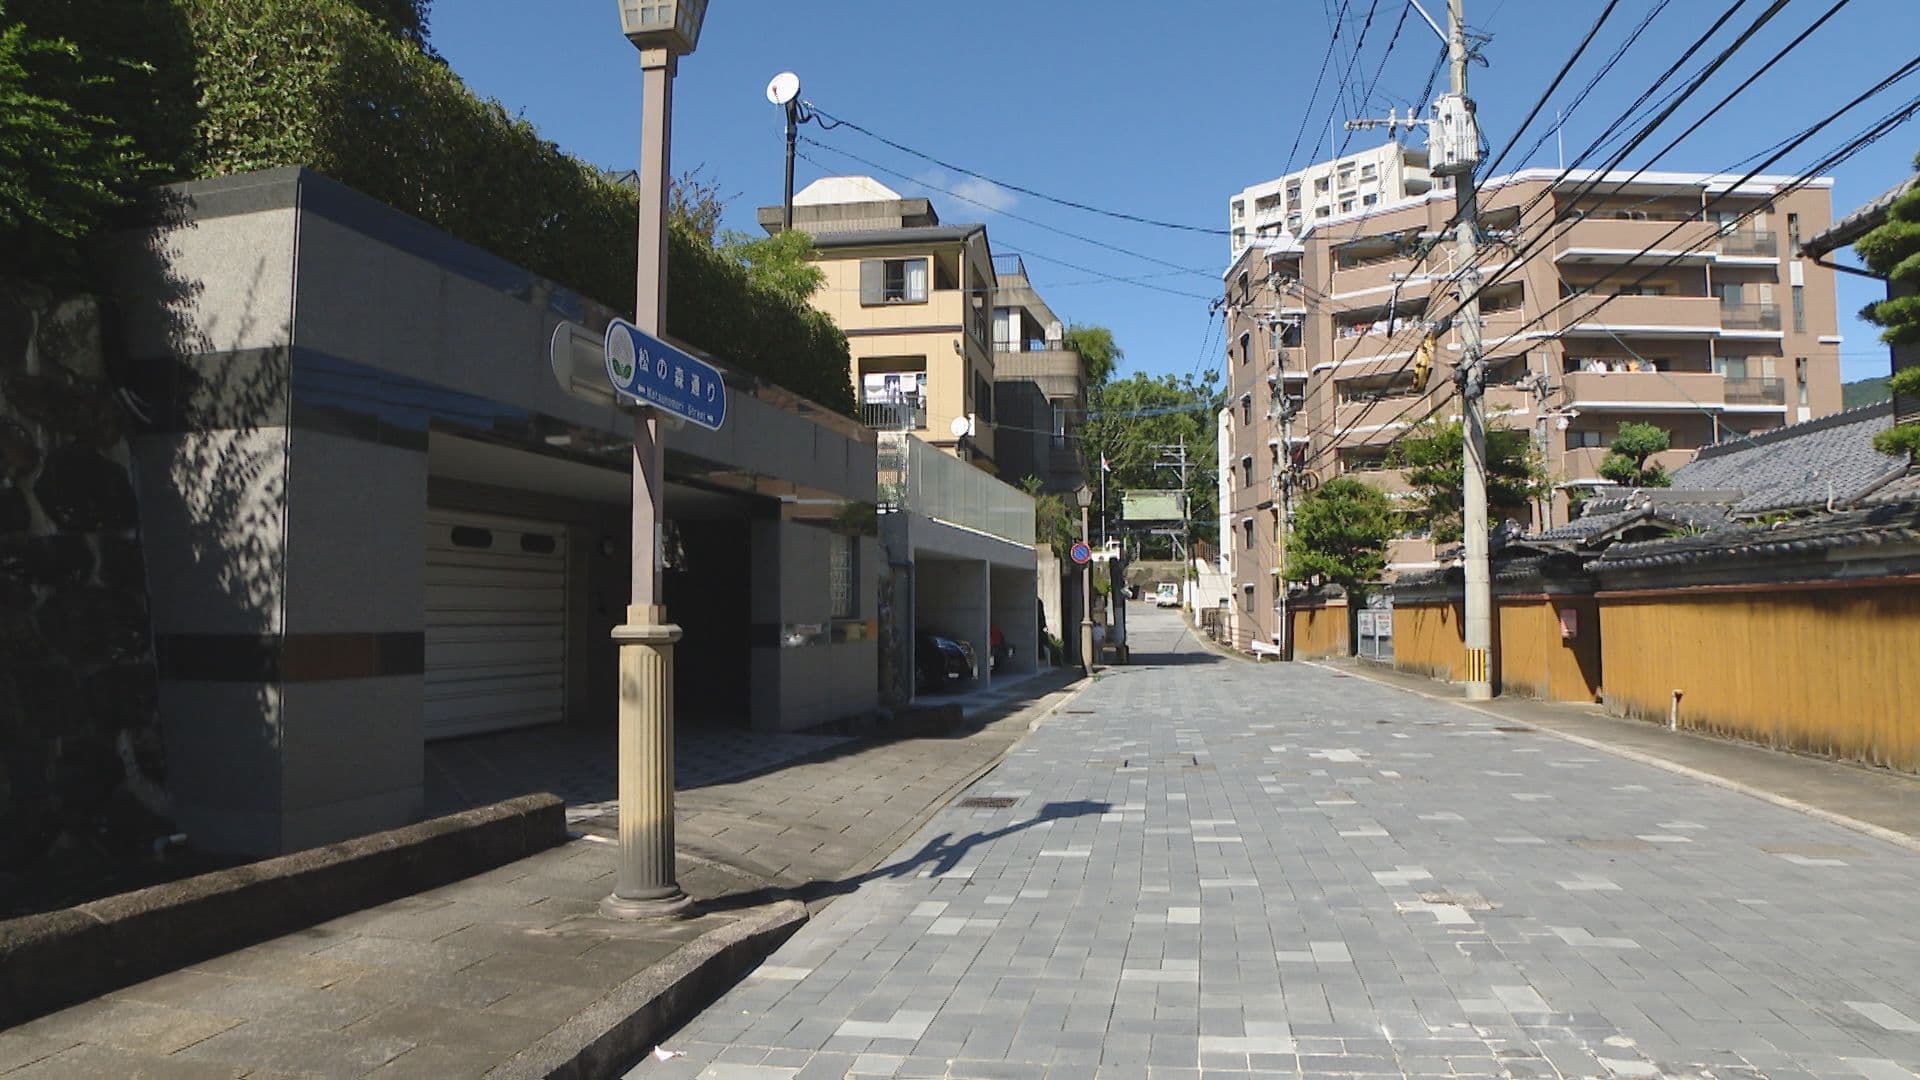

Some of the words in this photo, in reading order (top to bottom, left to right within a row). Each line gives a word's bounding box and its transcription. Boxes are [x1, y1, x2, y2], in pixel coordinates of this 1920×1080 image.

[638, 347, 716, 403] 松の森通り
